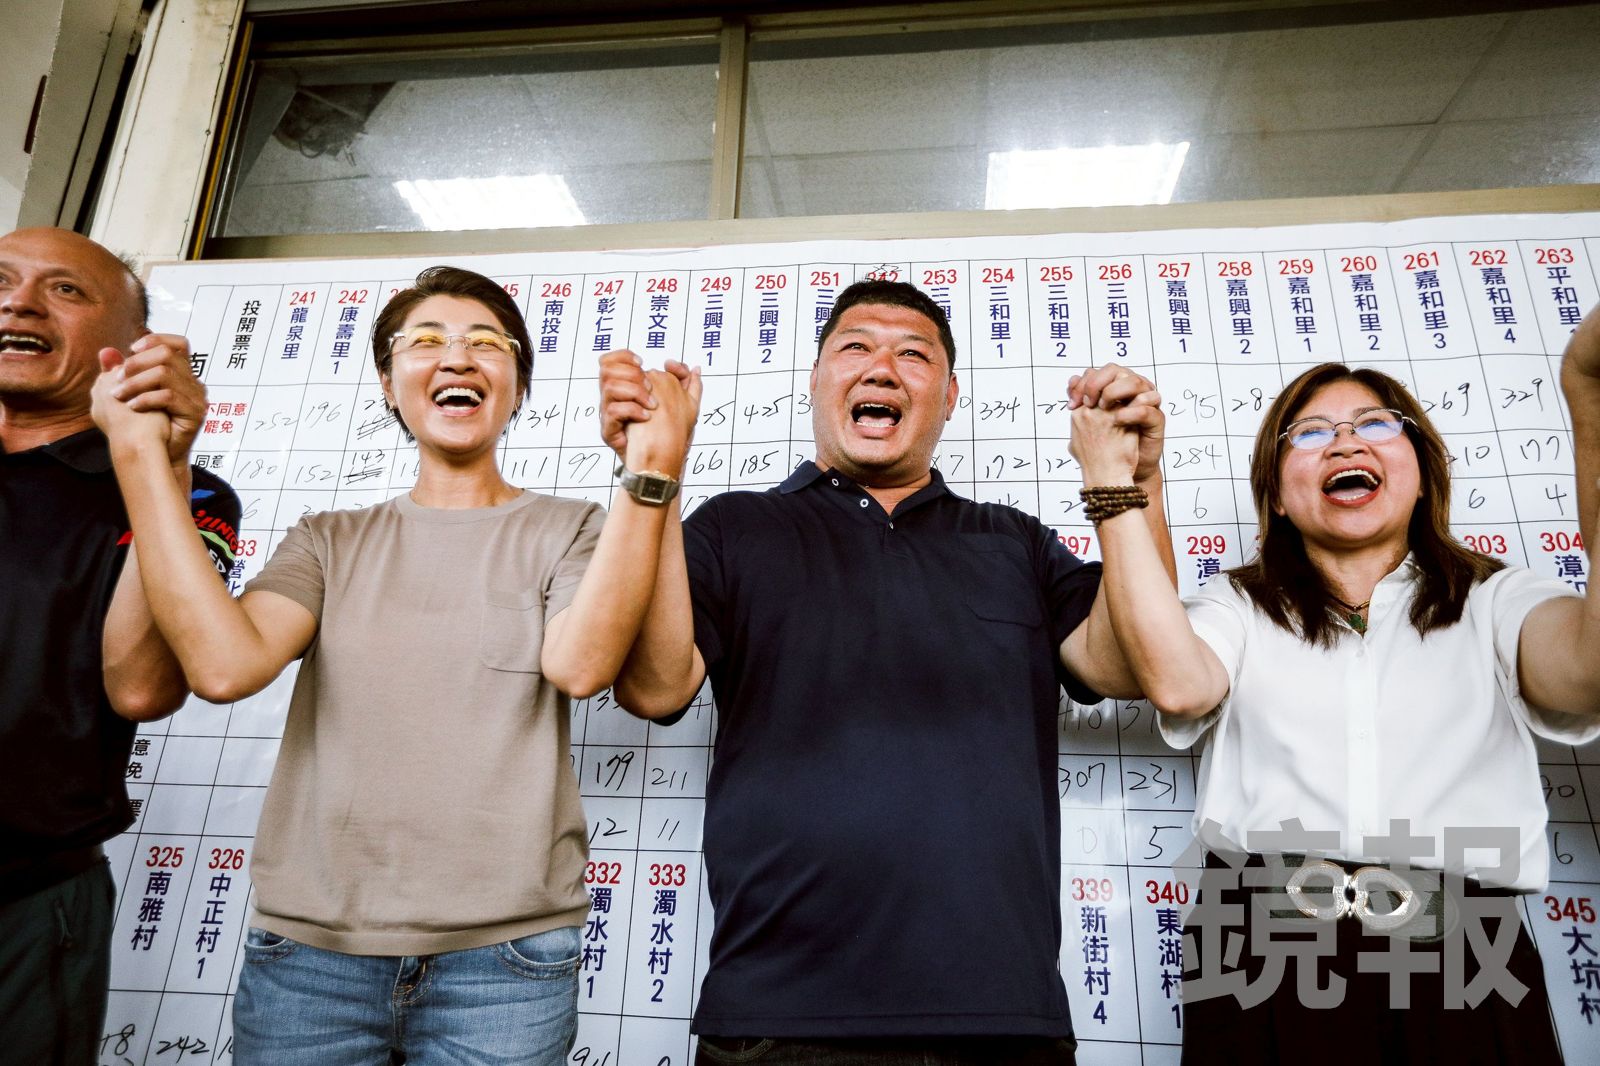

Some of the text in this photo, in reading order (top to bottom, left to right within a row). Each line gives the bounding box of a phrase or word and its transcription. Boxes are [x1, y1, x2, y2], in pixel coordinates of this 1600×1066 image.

[1340, 255, 1377, 272] 260
[1404, 251, 1440, 270] 261
[1469, 249, 1508, 266] 262
[1535, 247, 1574, 264] 263
[923, 269, 957, 285] 253
[982, 267, 1015, 283] 254
[1040, 266, 1073, 282] 255
[1098, 264, 1132, 280] 256
[1158, 262, 1191, 278] 257
[1217, 261, 1252, 277] 258
[1278, 259, 1314, 275] 259
[593, 280, 624, 296] 247
[646, 278, 678, 293] 248
[700, 276, 732, 292] 249
[755, 274, 787, 289] 250
[810, 271, 839, 286] 251
[289, 291, 316, 305] 241
[338, 289, 368, 304] 242
[541, 283, 572, 298] 246
[281, 307, 309, 359] 龍泉里
[538, 299, 564, 353] 南投里
[592, 297, 616, 352] 彰仁里
[645, 295, 670, 349] 崇文里
[226, 300, 261, 369] 投開票所
[1500, 378, 1543, 411] 329
[304, 401, 341, 429] 196
[979, 396, 1021, 422] 334
[1168, 389, 1218, 423] 295
[203, 420, 234, 434] 罷免
[1172, 444, 1223, 471] 284
[1520, 436, 1560, 462] 177
[195, 454, 224, 469] 同意
[237, 459, 278, 480] 180
[740, 450, 779, 477] 185
[986, 455, 1031, 479] 172
[295, 464, 337, 484] 152
[1193, 486, 1208, 519] 6
[1468, 488, 1486, 509] 6
[1545, 483, 1567, 516] 4
[1186, 535, 1226, 555] 299
[1463, 534, 1507, 555] 303
[1540, 531, 1585, 552] 304
[652, 767, 688, 791] 211
[1127, 762, 1177, 804] 231
[589, 817, 628, 844] 12
[1144, 825, 1183, 860] 5
[1554, 831, 1574, 865] 6
[146, 846, 185, 868] 325
[208, 848, 245, 870] 326
[584, 861, 622, 885] 332
[648, 863, 687, 887] 333
[1071, 877, 1113, 902] 339
[1145, 880, 1189, 905] 340
[130, 870, 172, 951] 南雅村
[1543, 895, 1596, 923] 345
[156, 1035, 210, 1064] 242
